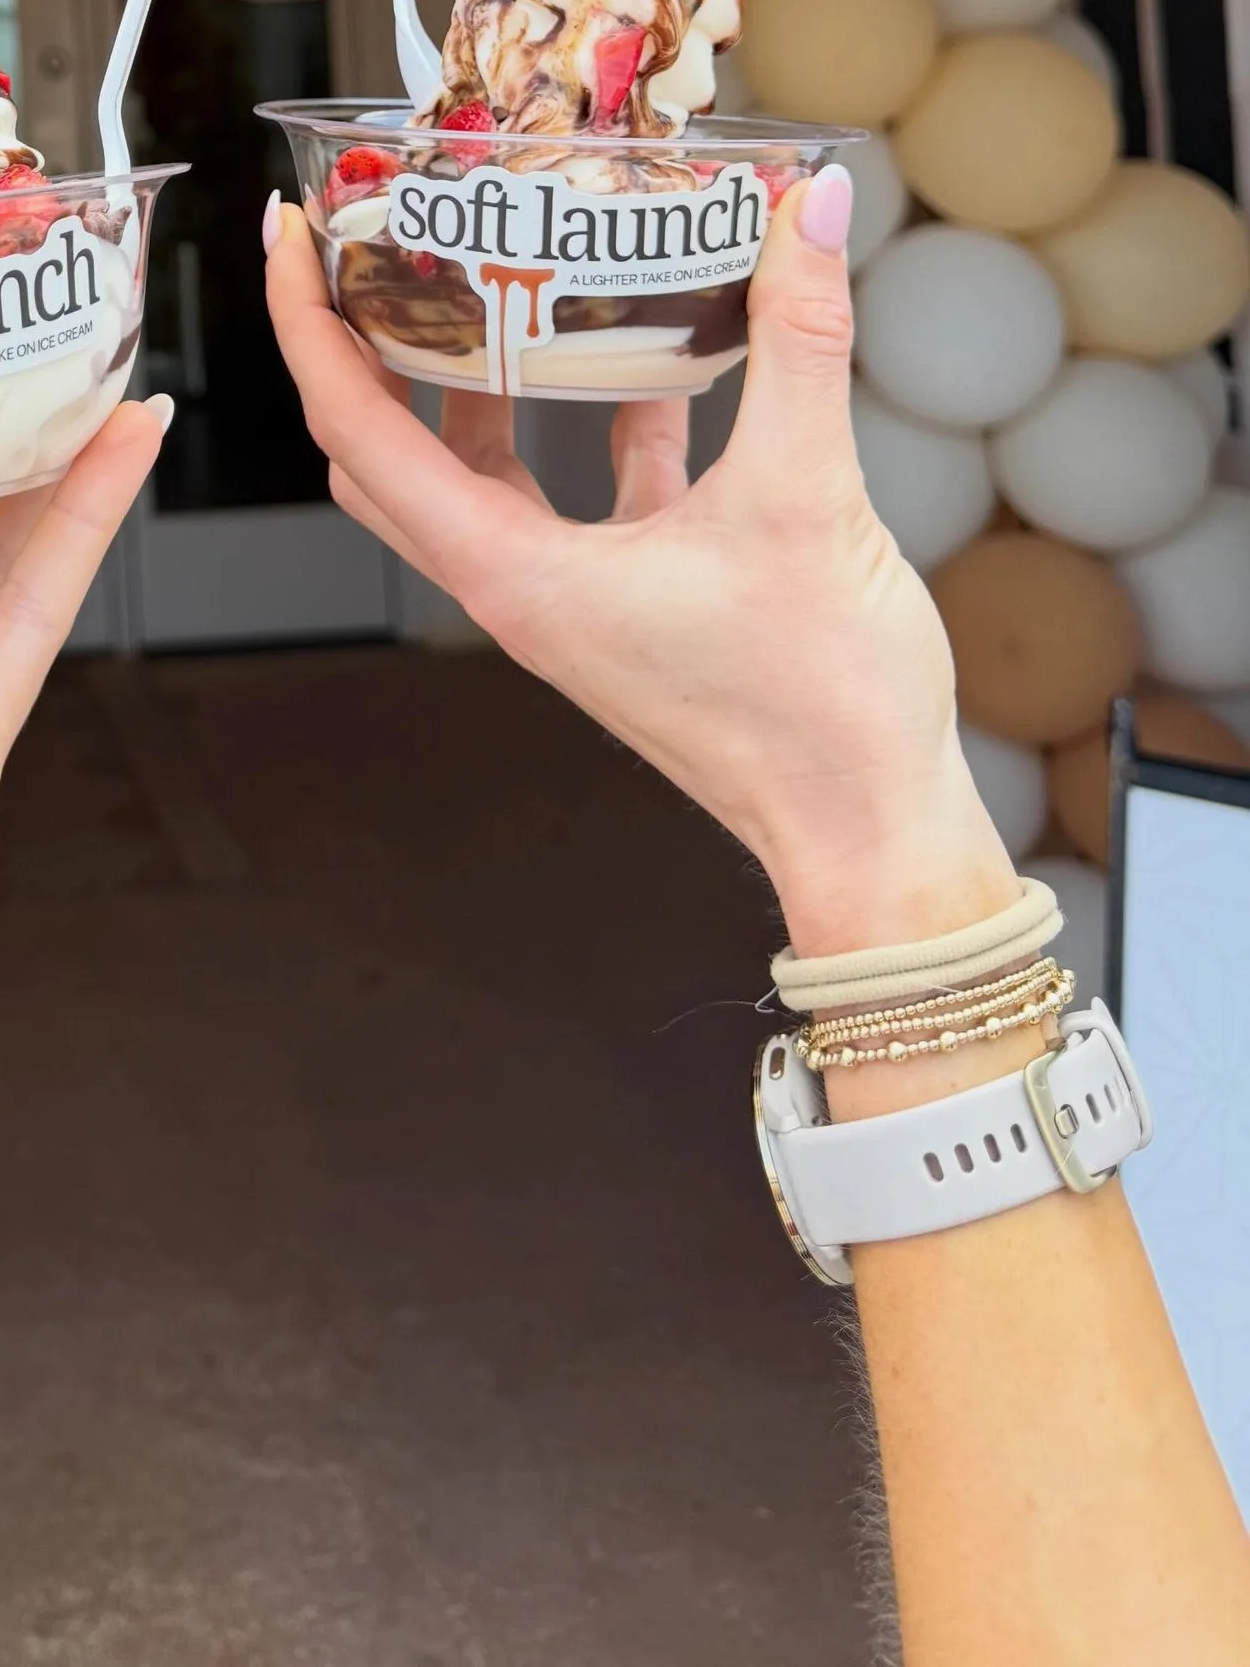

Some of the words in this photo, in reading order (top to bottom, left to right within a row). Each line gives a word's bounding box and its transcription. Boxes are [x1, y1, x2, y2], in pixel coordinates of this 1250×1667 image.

[399, 179, 518, 257] soft
[533, 175, 760, 262] launch
[570, 275, 580, 285] A
[582, 274, 638, 286] LIGHTER
[641, 271, 671, 284] TAKE
[673, 267, 692, 282] ON
[694, 265, 712, 278] ICE
[713, 256, 751, 274] CREAM
[16, 341, 36, 358] ON
[37, 337, 56, 354] ICE
[57, 319, 93, 346] CREAM
